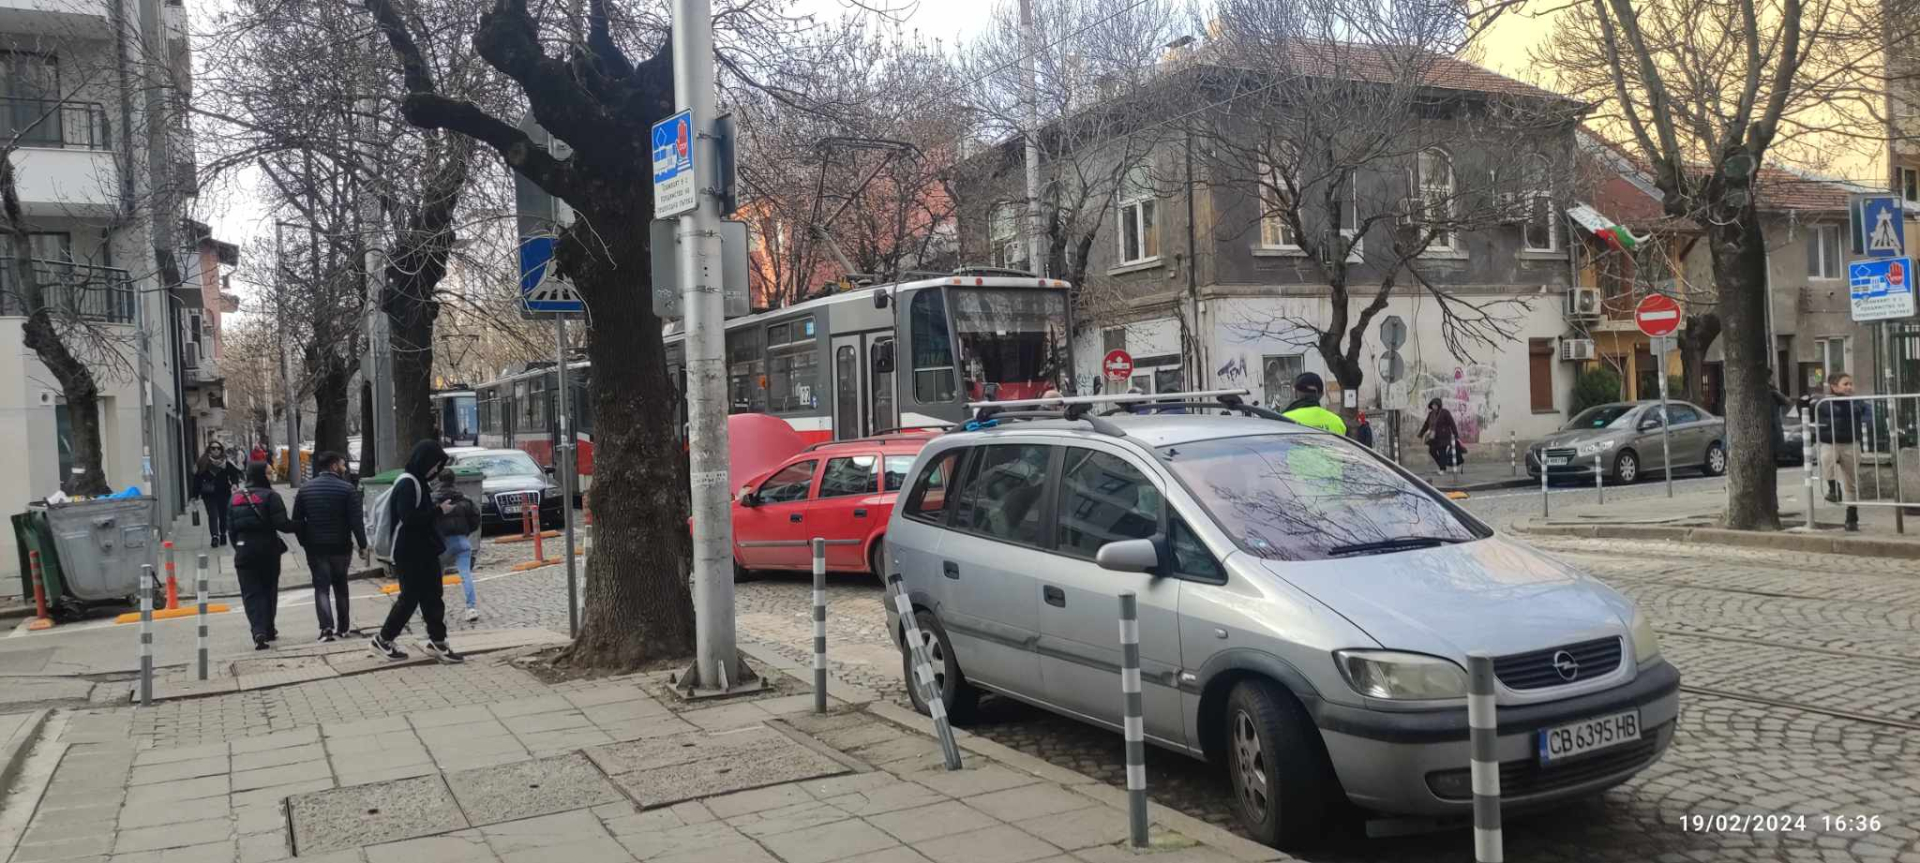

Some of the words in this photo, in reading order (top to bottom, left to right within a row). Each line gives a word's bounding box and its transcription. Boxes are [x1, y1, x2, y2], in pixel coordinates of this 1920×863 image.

[1549, 729, 1573, 755] CB
[1576, 720, 1613, 749] 6395
[1615, 714, 1636, 740] HB
